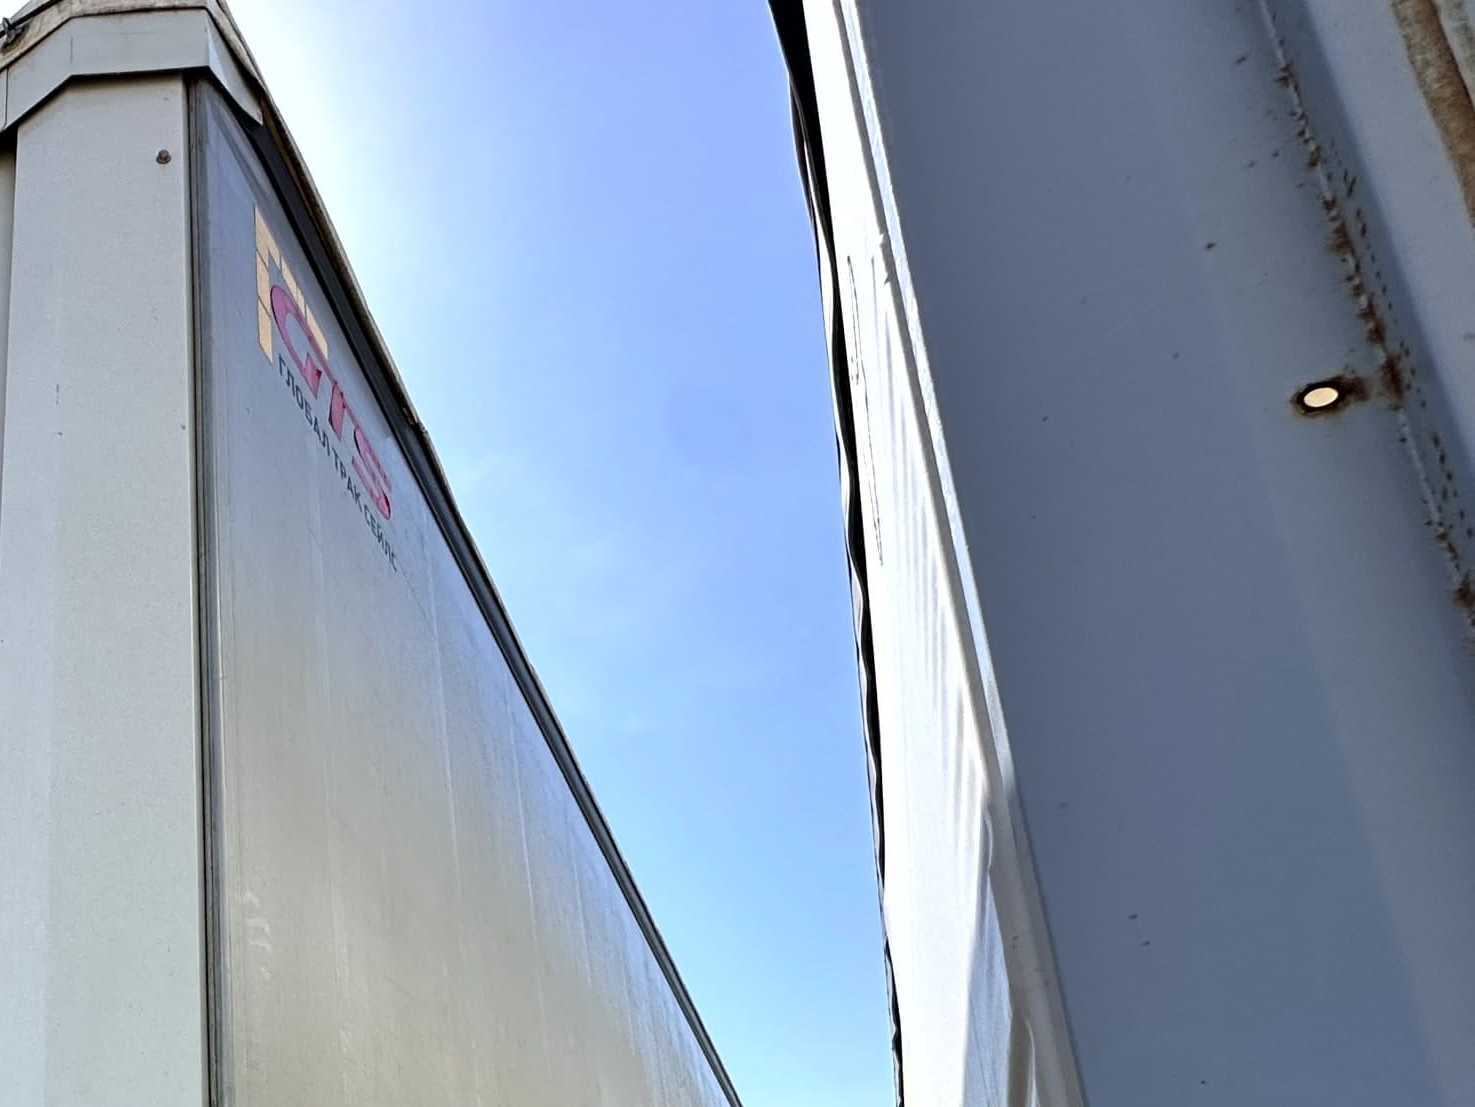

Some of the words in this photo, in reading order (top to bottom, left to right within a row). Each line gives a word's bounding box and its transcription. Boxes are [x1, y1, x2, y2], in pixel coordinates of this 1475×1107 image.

[269, 284, 392, 521] GTS
[278, 352, 331, 457] ГЛОБАЛ
[332, 447, 363, 513] ТРАК
